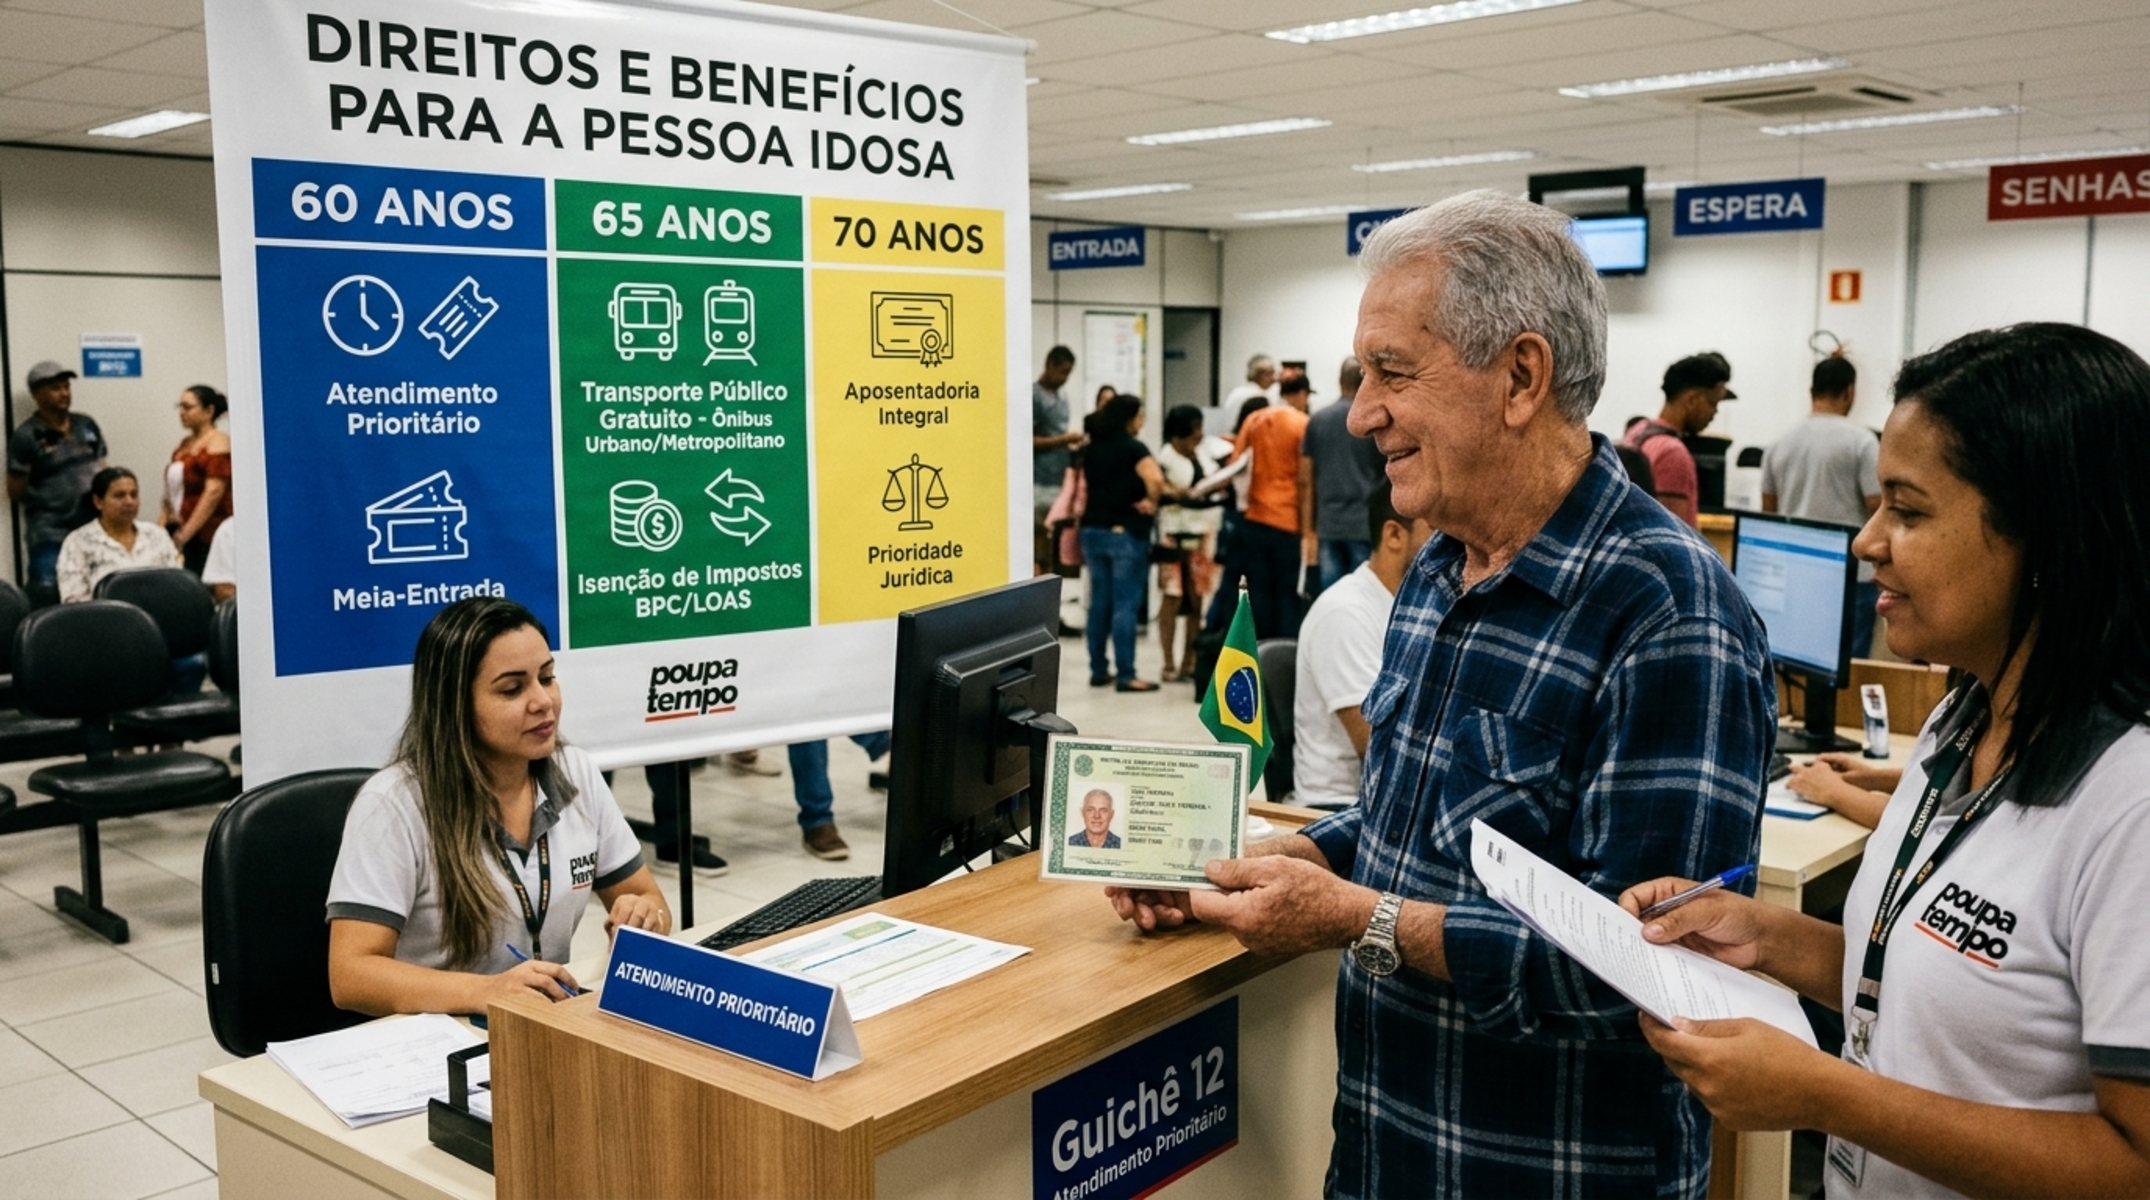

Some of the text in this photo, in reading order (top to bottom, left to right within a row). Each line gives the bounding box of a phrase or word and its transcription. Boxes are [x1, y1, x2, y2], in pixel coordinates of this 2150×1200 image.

[307, 13, 964, 127] DIREITOS E BENEFÍCIOS
[329, 83, 955, 180] PARA A PESSOA IDOSA
[2001, 169, 2150, 206] SENHAS
[291, 181, 514, 230] 60 ANOS
[1689, 192, 1808, 223] ESPERA
[592, 200, 772, 244] 65 ANOS
[833, 215, 984, 254] 70 ANOS
[1052, 237, 1140, 260] ENTRADA
[326, 381, 499, 405] Atendimento
[580, 380, 788, 406] Transporte Público
[844, 381, 980, 404] Aposentadoria
[348, 411, 481, 435] Prioritário
[599, 408, 692, 429] Gratuito
[712, 406, 773, 428] Ônibus
[879, 406, 948, 428] Integral
[868, 540, 963, 564] Prioridade
[578, 561, 803, 594] Isenção de Impostos
[333, 578, 505, 611] Meia-Entrada
[636, 589, 752, 618] BPC/LOAS
[650, 658, 738, 687] poupa
[647, 685, 738, 715] tempo
[1930, 882, 2017, 935] poupa
[614, 961, 816, 1037] ATENDIMENTO PRIORITÁRIO
[1052, 1046, 1225, 1173] Guichê 12
[1155, 1104, 1227, 1156] Prioritário
